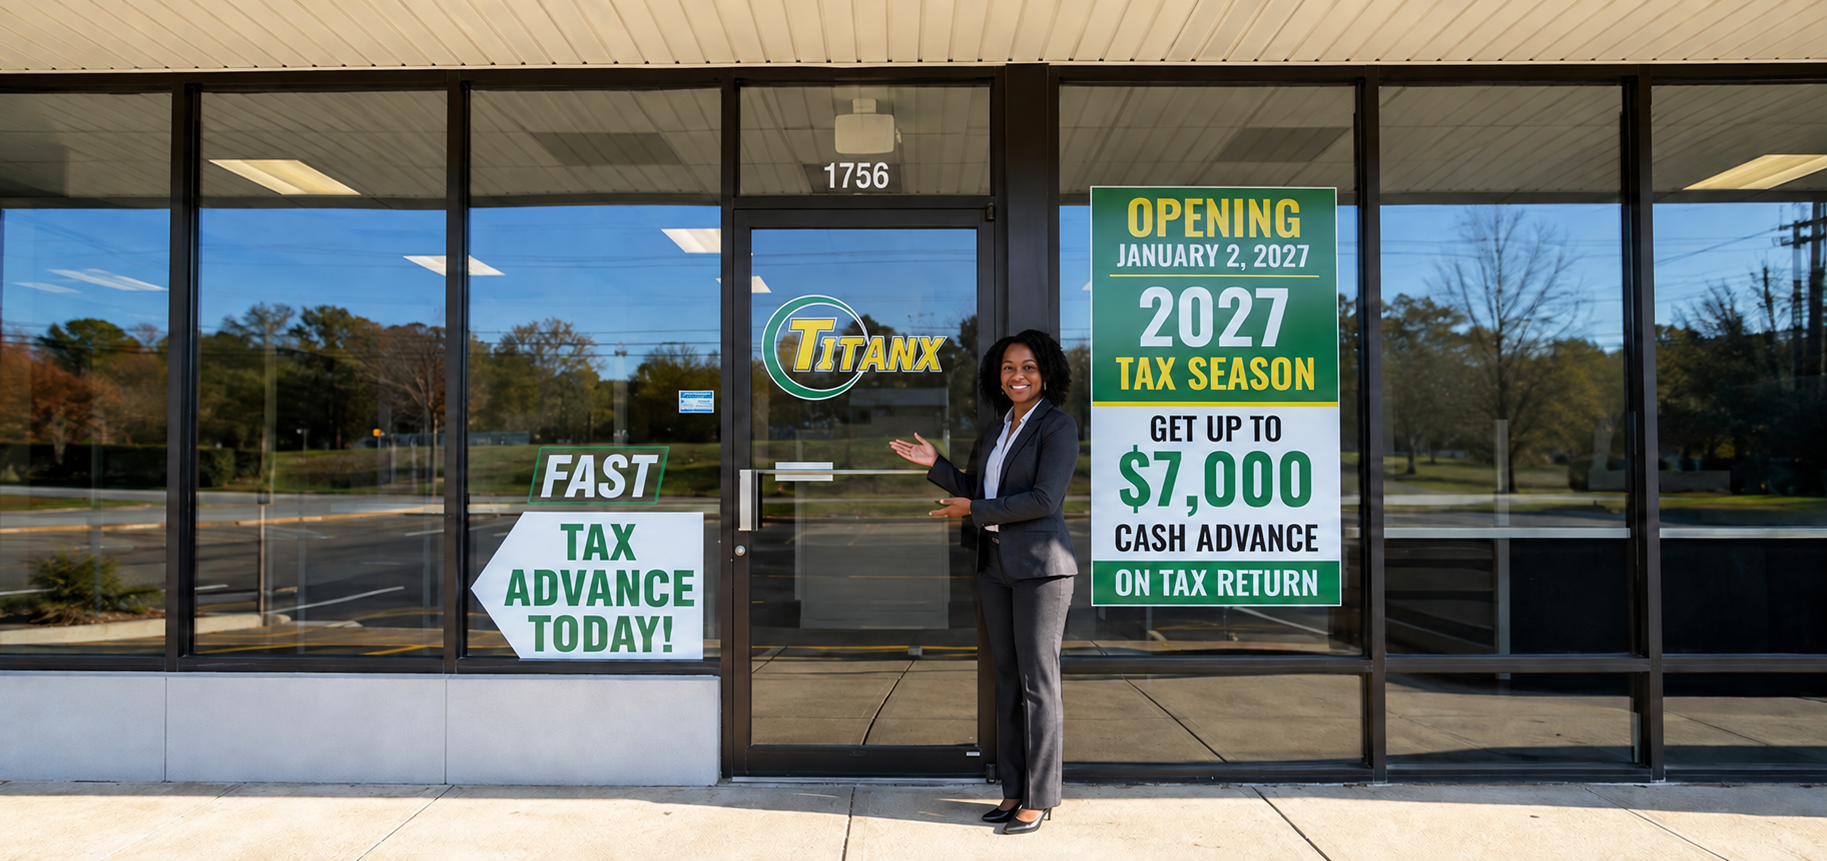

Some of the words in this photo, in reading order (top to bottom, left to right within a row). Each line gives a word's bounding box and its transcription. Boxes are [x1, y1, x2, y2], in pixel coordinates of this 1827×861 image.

[824, 162, 889, 189] 1756
[1127, 197, 1300, 238] OPENING
[1117, 243, 1219, 267] JANUARY
[1226, 244, 1246, 271] 2,
[1254, 244, 1310, 268] 2027
[1139, 286, 1289, 348] 2027
[1115, 356, 1176, 391] TAX
[1187, 356, 1315, 391] SEASON
[1150, 415, 1197, 442] GET
[1207, 415, 1242, 442] UP
[1250, 415, 1282, 442] TO
[540, 453, 659, 499] FAST
[1119, 444, 1312, 517] $7,000
[560, 523, 637, 561] TAX
[1115, 523, 1186, 552] CASH
[1196, 523, 1319, 552] ADVANCE
[504, 569, 695, 608] ADVANCE
[1115, 568, 1150, 597] ON
[1159, 569, 1207, 597] TAX
[1217, 569, 1318, 597] RETURN
[527, 614, 673, 653] TODAY!
